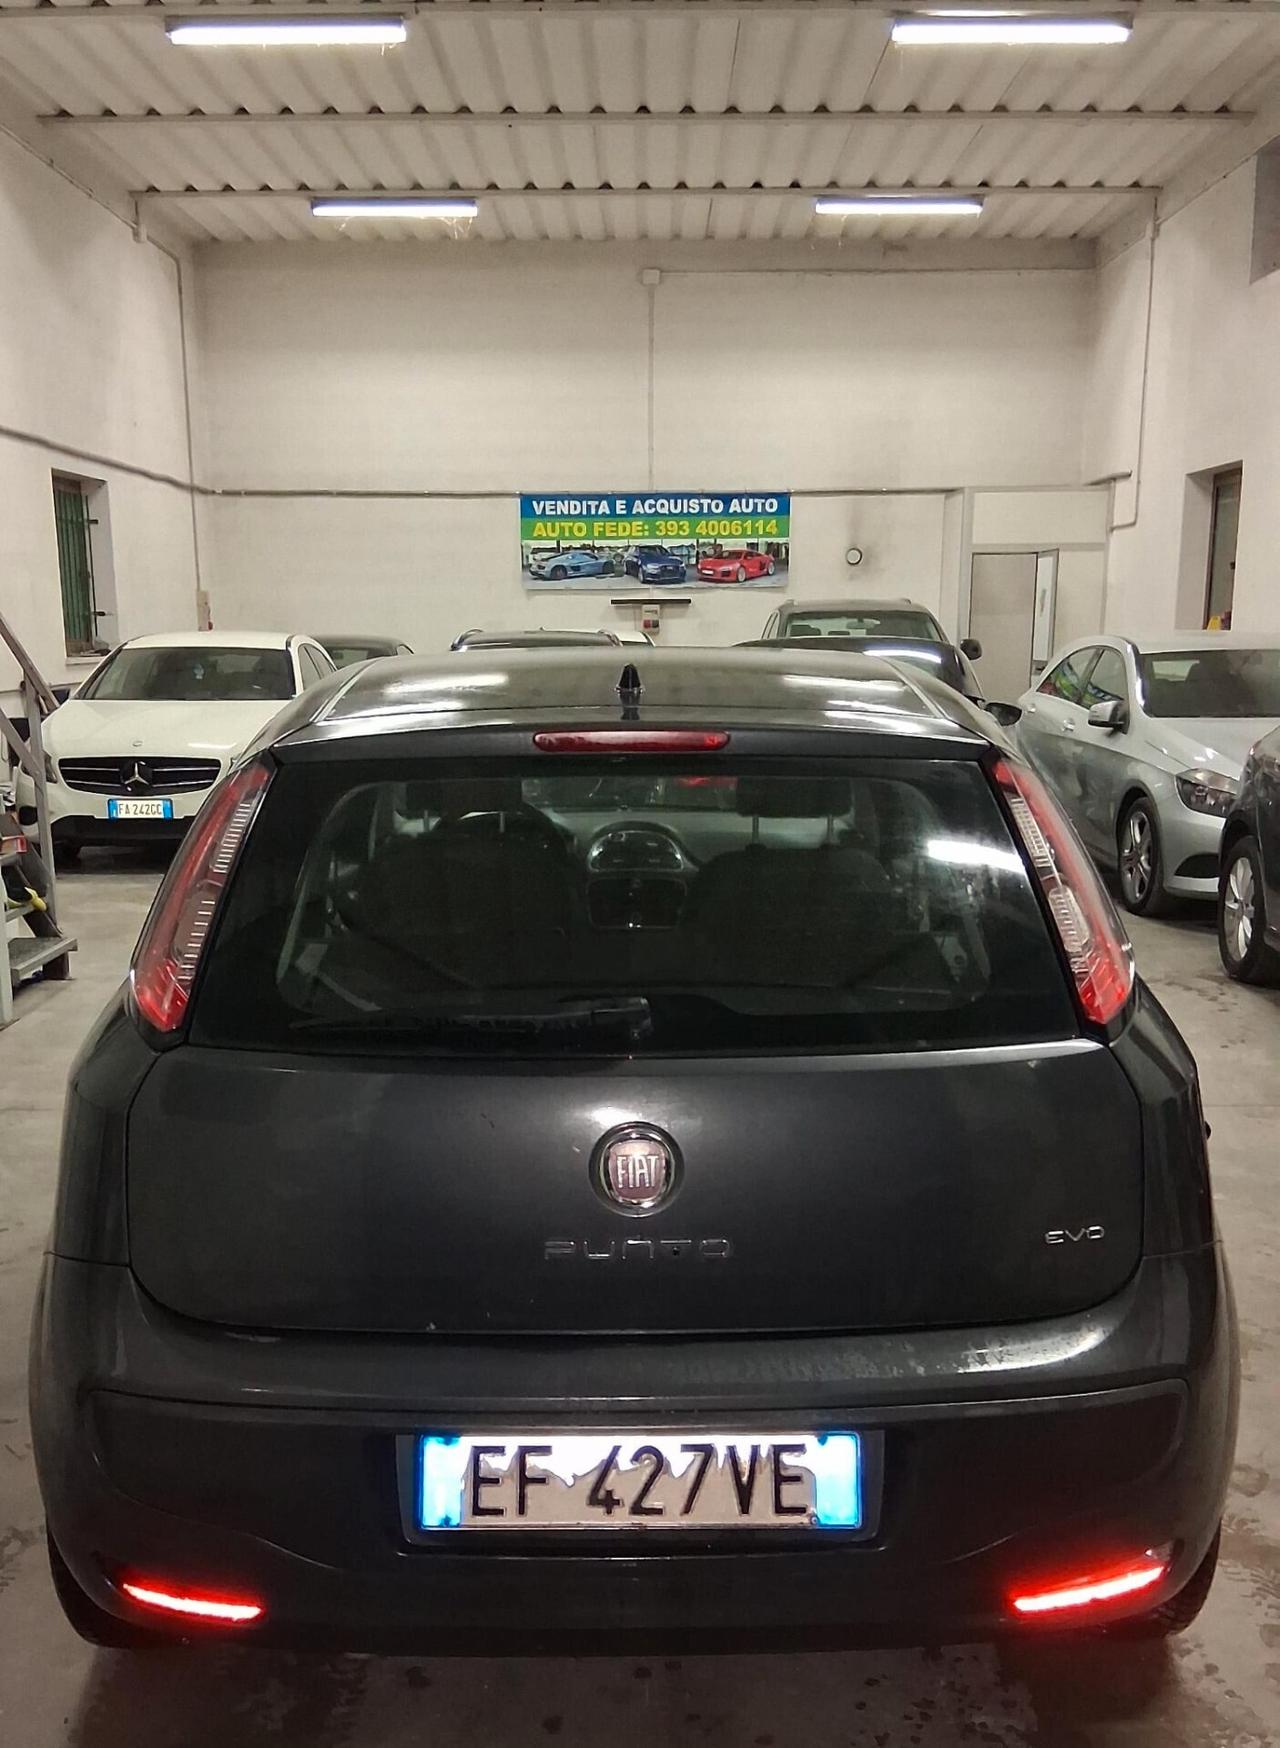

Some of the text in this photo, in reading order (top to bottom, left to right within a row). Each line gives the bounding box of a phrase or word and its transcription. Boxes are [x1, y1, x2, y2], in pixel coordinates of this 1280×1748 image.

[532, 498, 778, 515] VENDITA E ACQUISTO AUTO
[533, 519, 778, 537] AUTO FEDE: 393 4006114
[616, 1154, 659, 1188] FIAT
[1045, 1225, 1105, 1244] EVO
[545, 1238, 731, 1259] PUNTO
[471, 1444, 807, 1517] EF 427VE
